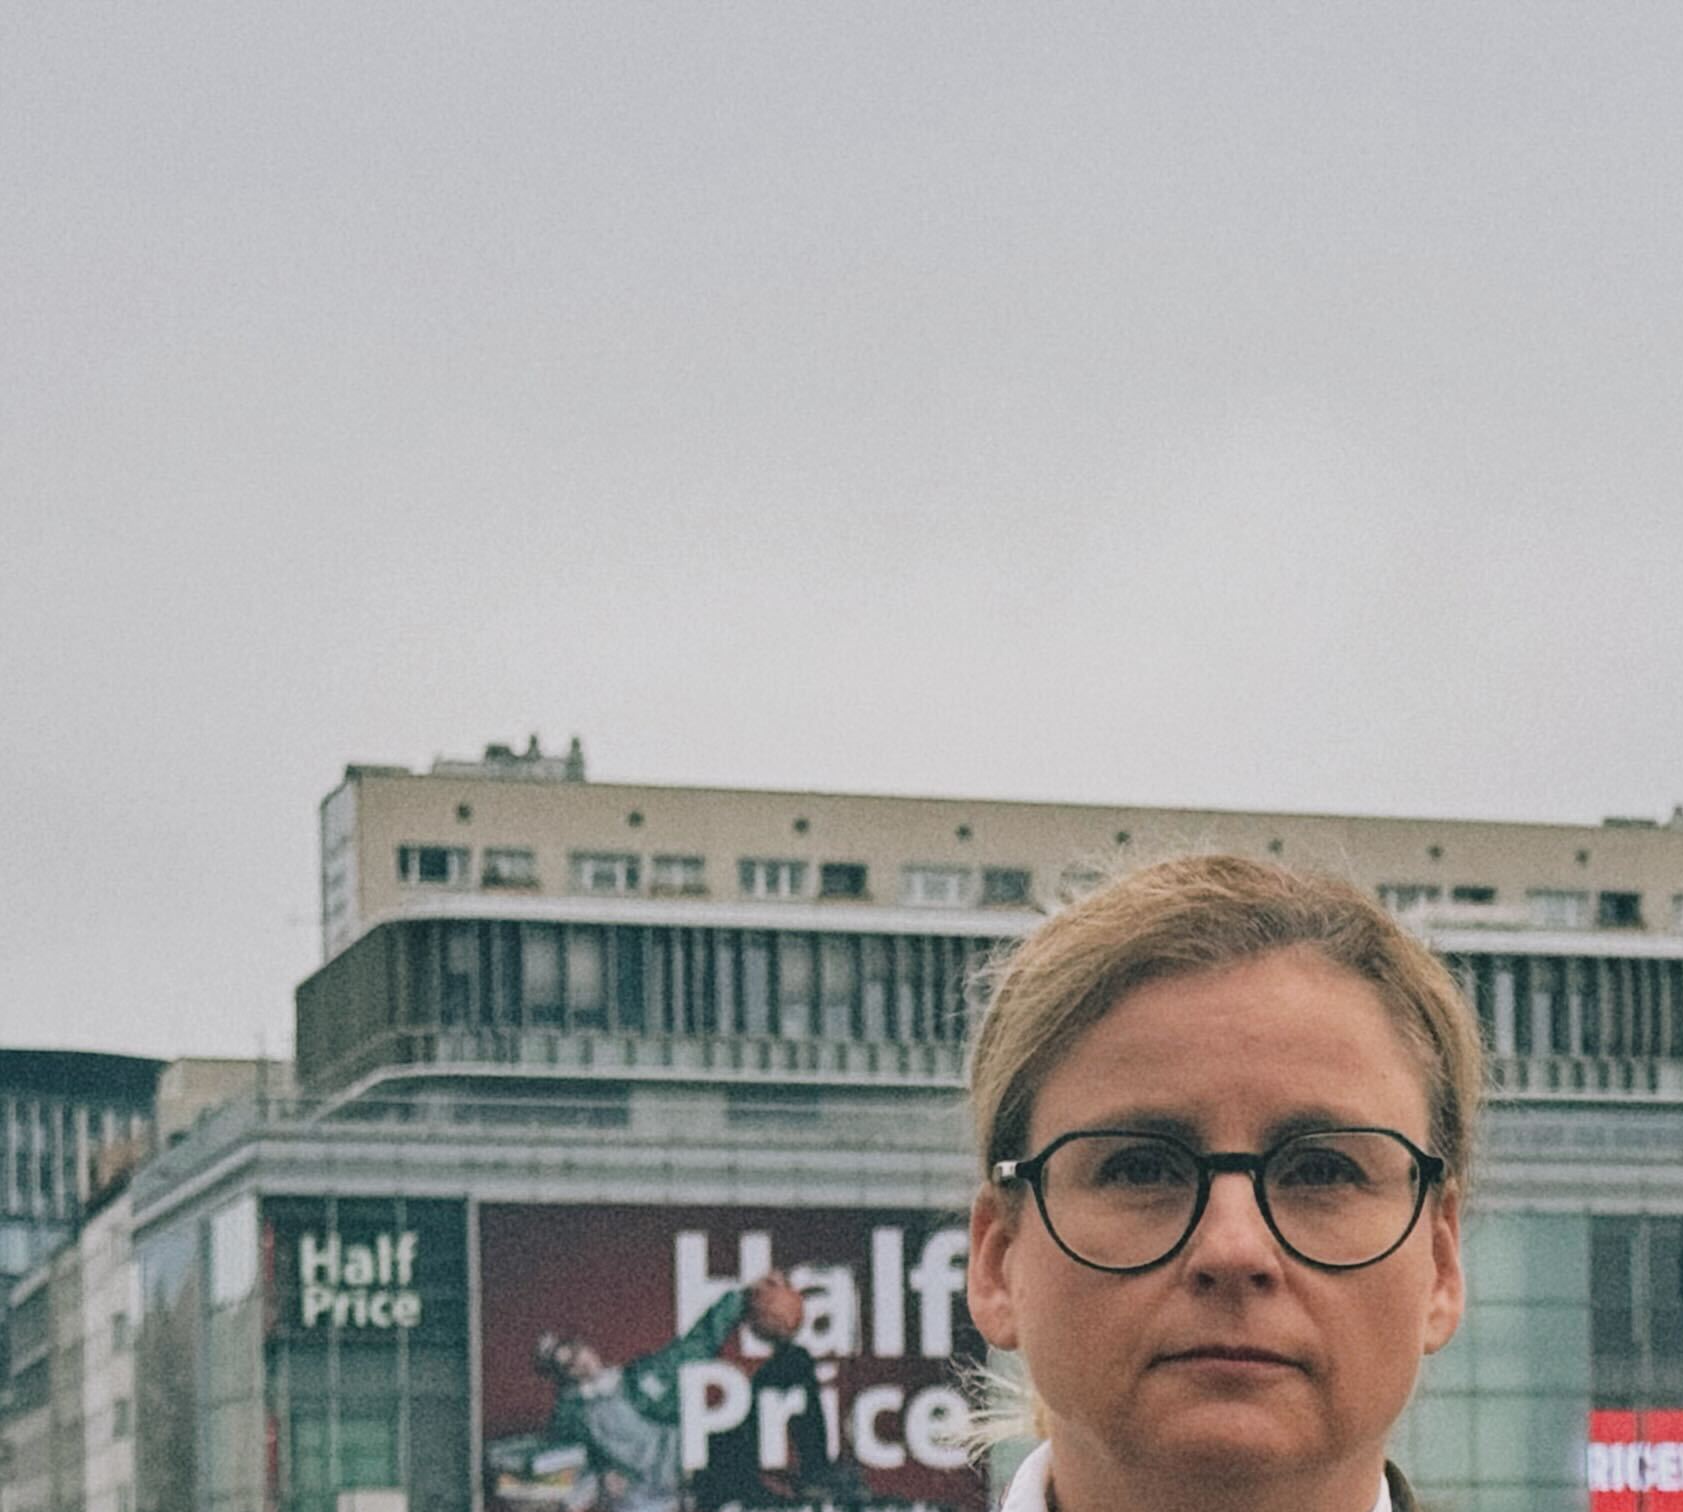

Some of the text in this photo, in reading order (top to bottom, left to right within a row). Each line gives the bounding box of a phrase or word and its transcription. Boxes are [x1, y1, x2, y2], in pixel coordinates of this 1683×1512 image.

[302, 1232, 418, 1285] Half
[676, 1227, 970, 1357] Half
[303, 1286, 421, 1328] Price
[679, 1360, 971, 1470] Price
